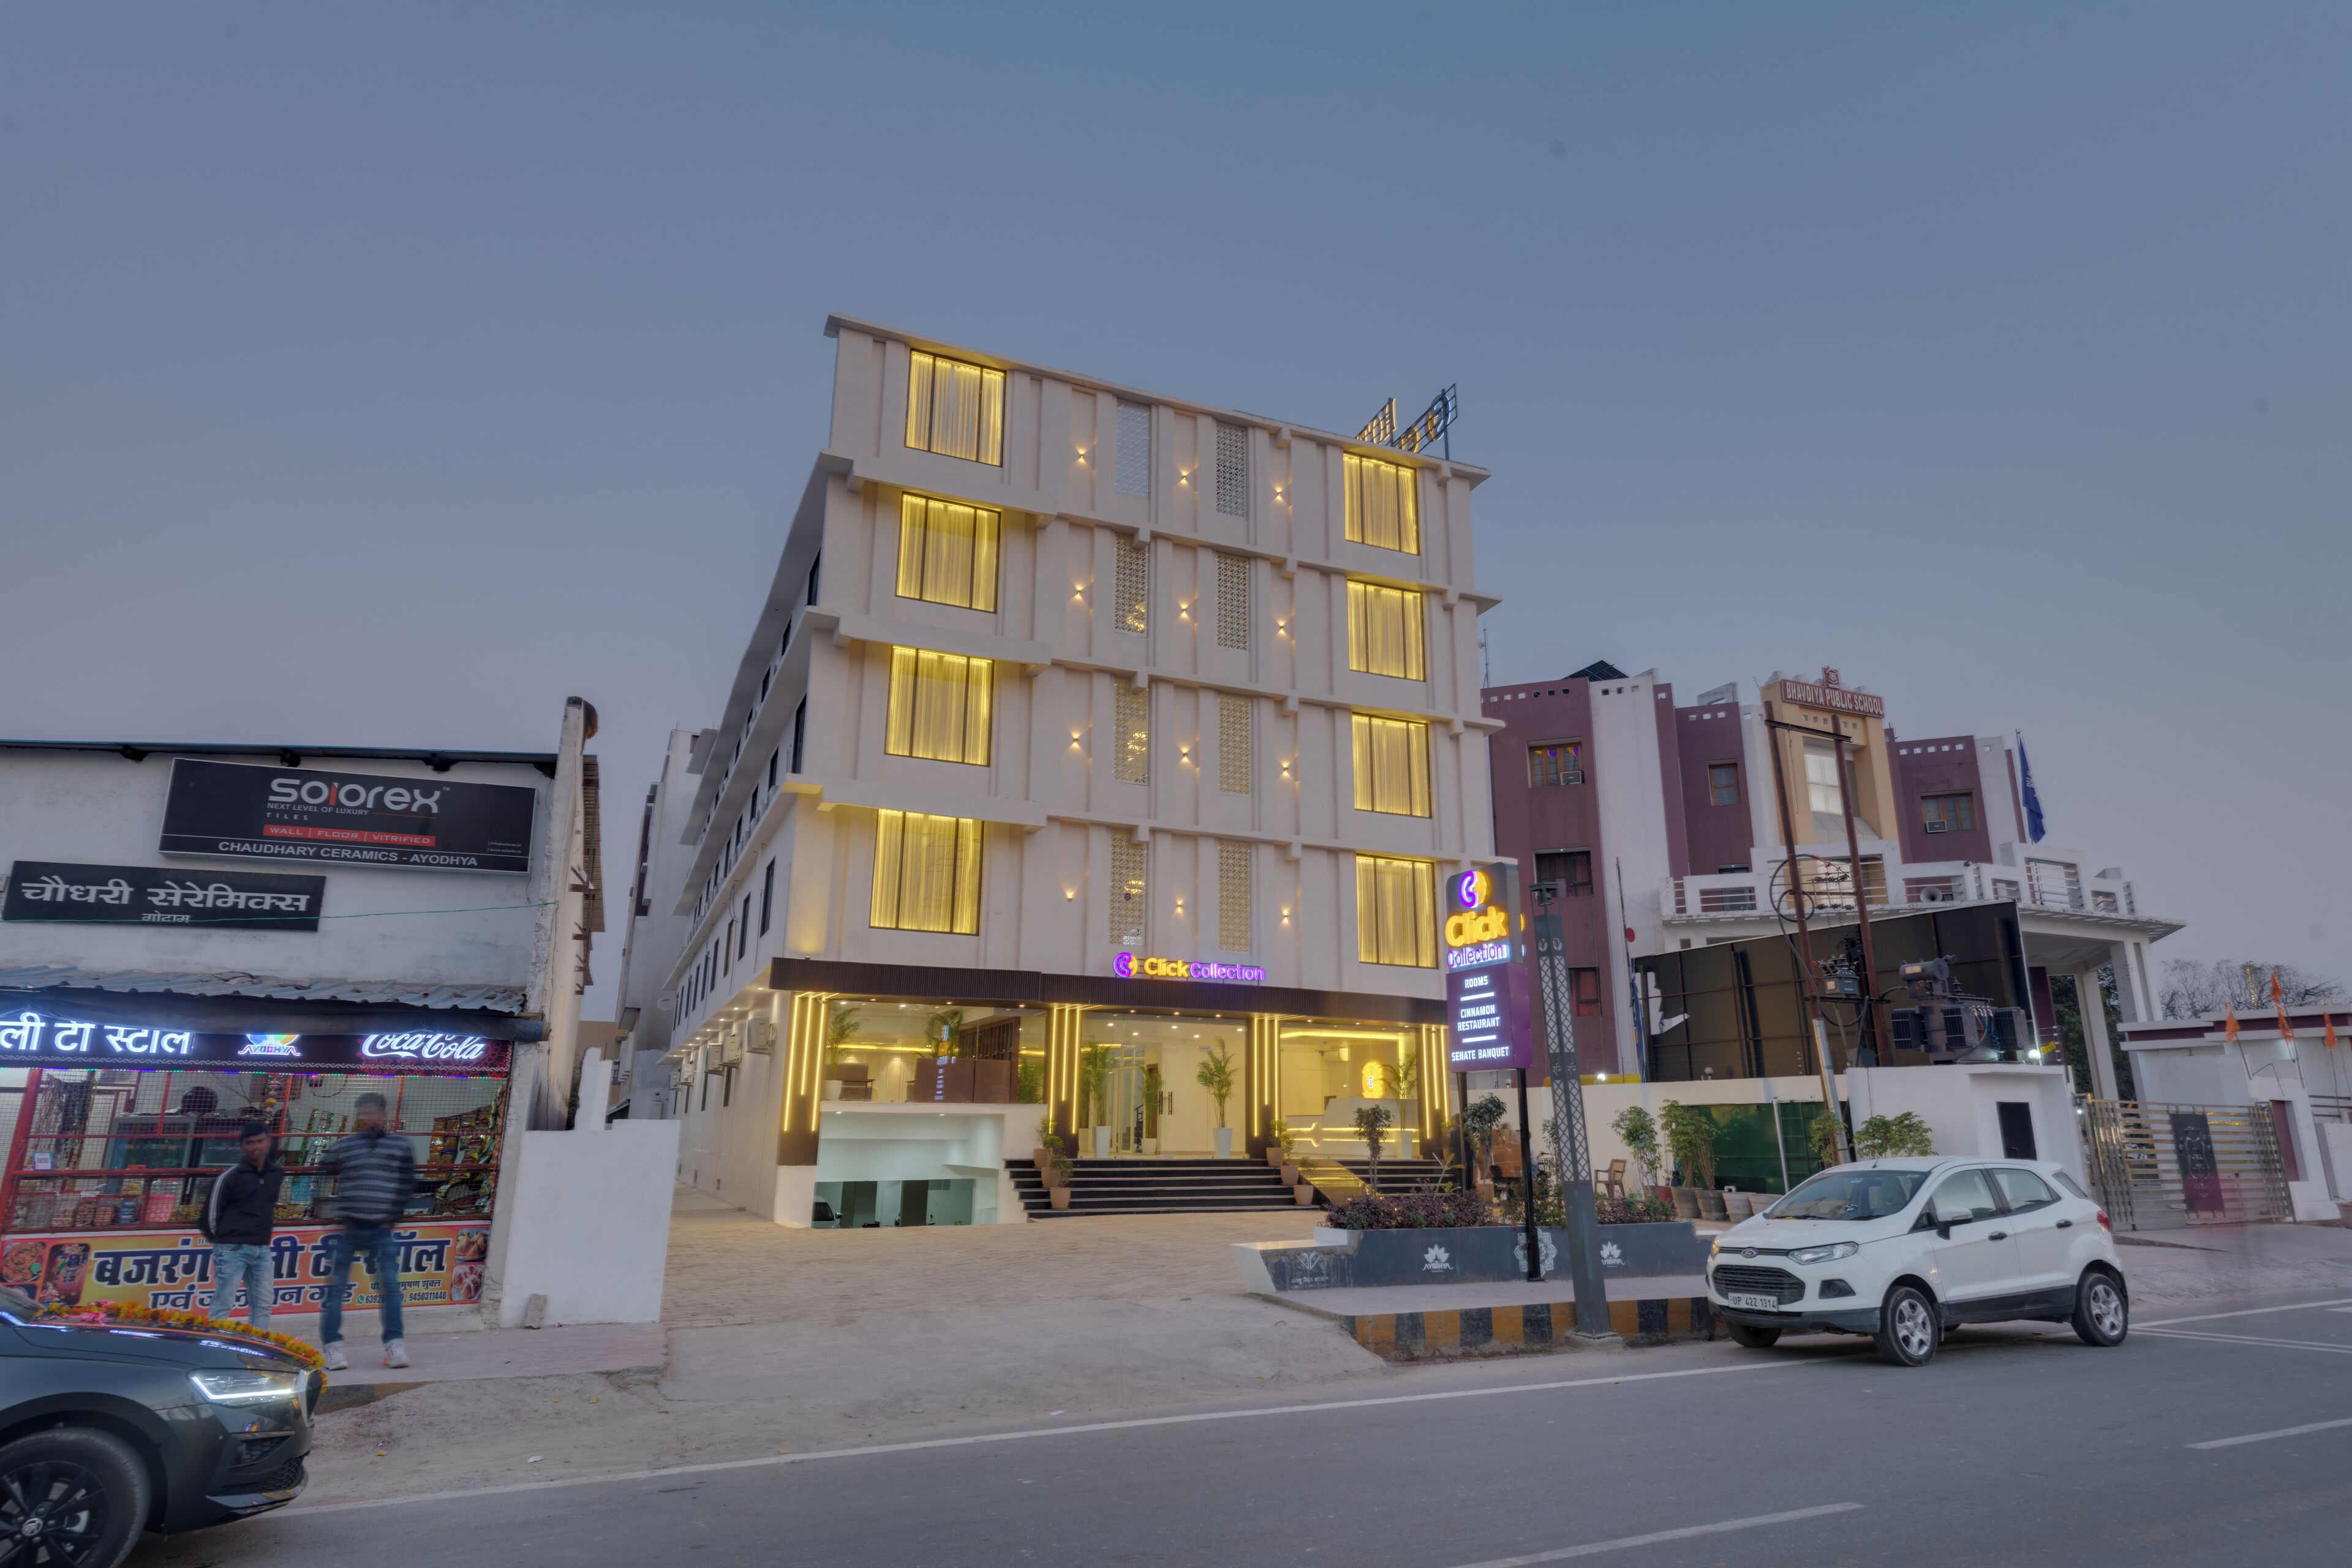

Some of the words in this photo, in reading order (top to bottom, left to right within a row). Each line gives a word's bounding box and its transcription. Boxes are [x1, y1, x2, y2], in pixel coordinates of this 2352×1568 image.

[1785, 682, 1825, 705] BHAVDIYA
[1825, 689, 1853, 710] PUBLIC
[1853, 695, 1883, 715] SCHOOL
[266, 812, 309, 821] TILES
[270, 827, 304, 835] WALL
[317, 830, 359, 839] FLOOR
[372, 834, 430, 844] VITRIFIED
[218, 841, 317, 856] CHAUDHARY
[320, 847, 399, 862] CERAMICS
[409, 853, 478, 866] AYODHYA
[21, 875, 134, 905] चौधरी
[146, 880, 311, 912] सेरेमिक्स
[141, 910, 191, 923] गोदाम
[1445, 906, 1508, 947] Click
[1446, 943, 1507, 968] Collection
[1144, 957, 1189, 978] Click
[1189, 961, 1267, 981] Collection
[1464, 975, 1488, 989] ROOMS
[1460, 1004, 1496, 1019] CINNAMON
[1457, 1016, 1500, 1031] RESTAURANT
[1451, 1049, 1476, 1062] SENATE
[1477, 1046, 1509, 1060] BANQUET
[151, 1284, 196, 1310] एवं
[409, 1291, 447, 1302] 9450311440
[1733, 1296, 1742, 1305] UP
[1745, 1297, 1758, 1307] 42Z
[1760, 1298, 1776, 1309] 1314
